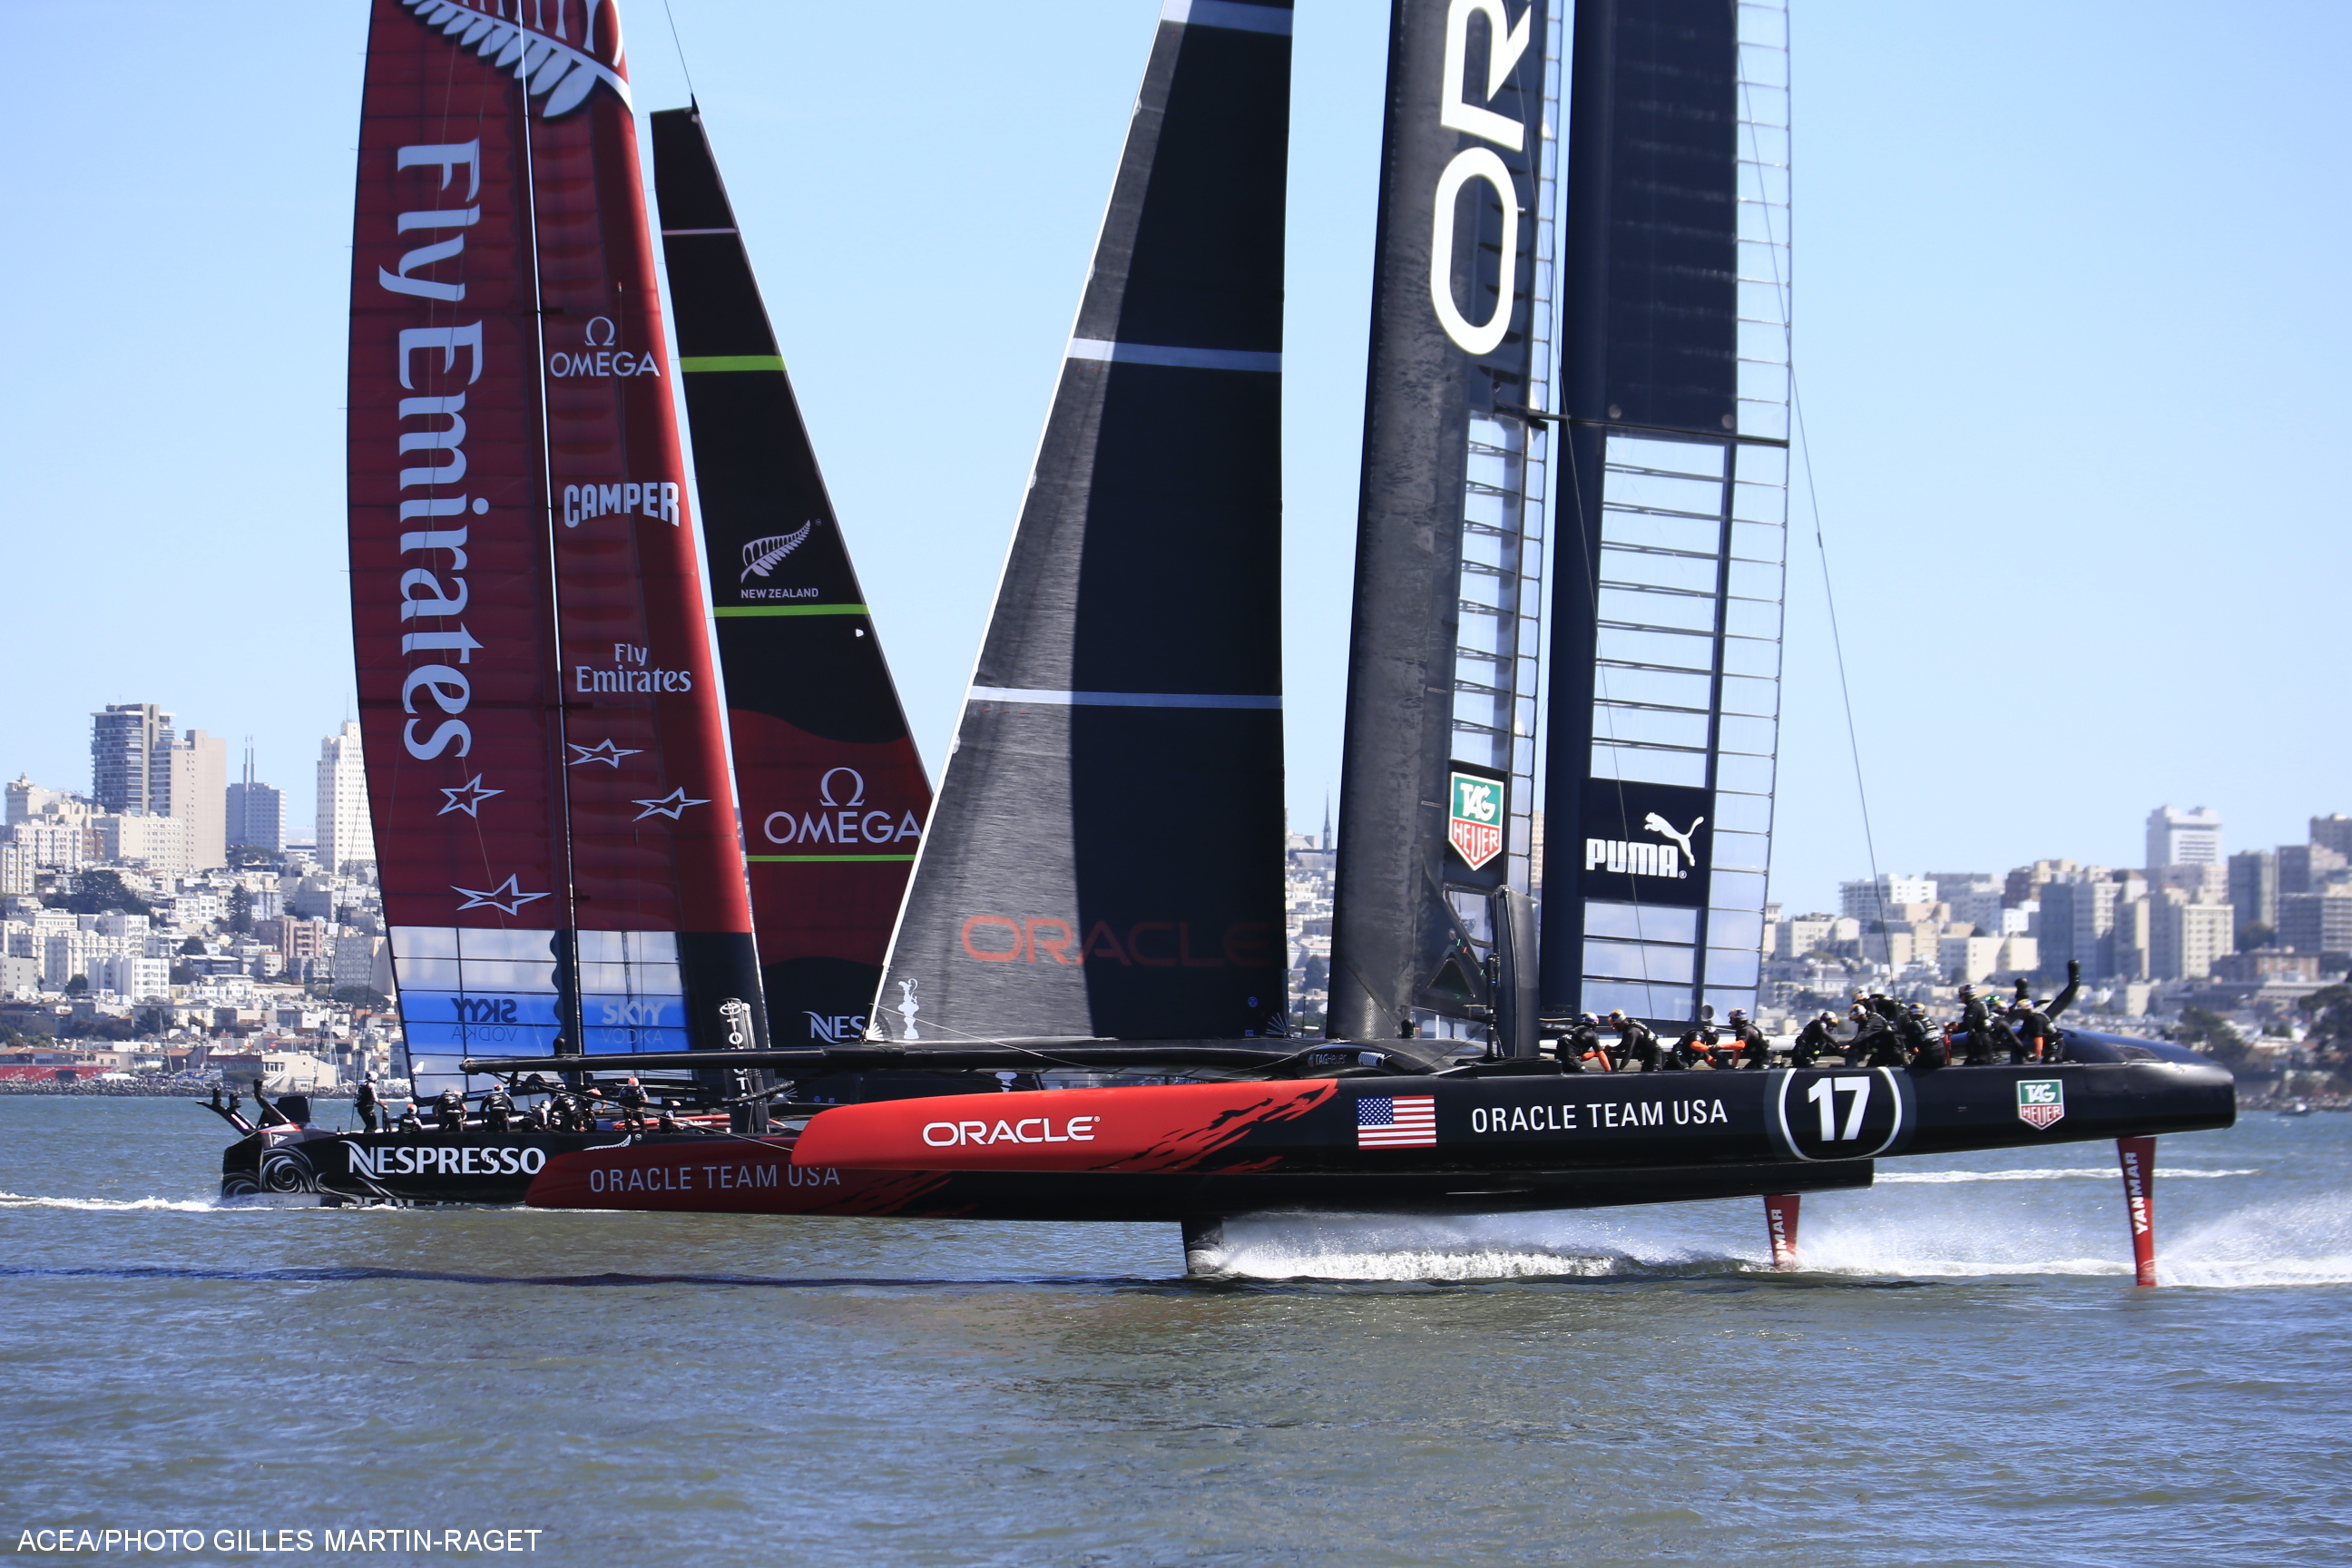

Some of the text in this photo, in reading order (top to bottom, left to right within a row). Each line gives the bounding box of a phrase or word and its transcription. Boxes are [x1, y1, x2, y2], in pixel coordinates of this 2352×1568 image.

[1431, 0, 1532, 355] OR
[550, 351, 662, 377] OMEGA
[378, 138, 490, 760] Fly Emirates
[564, 482, 680, 528] CAMPER
[740, 588, 818, 599] NEW ZEALAND
[614, 643, 648, 666] Fly
[576, 664, 691, 692] Emirates
[1460, 782, 1495, 821] TAG
[764, 810, 924, 844] OMEGA
[1454, 821, 1498, 863] HEUER
[961, 915, 1274, 967] ORACLE
[602, 1001, 667, 1025] SKYY
[601, 1027, 665, 1044] VODKA
[1808, 1076, 1871, 1142] 17
[2024, 1083, 2056, 1102] TAG
[1472, 1099, 1729, 1133] ORACLE TEAM USA
[2023, 1106, 2061, 1125] HEUER
[338, 1140, 546, 1180] NESPRESSO
[590, 1164, 840, 1193] ORACLE TEAM USA
[2125, 1152, 2149, 1235] YANMAR
